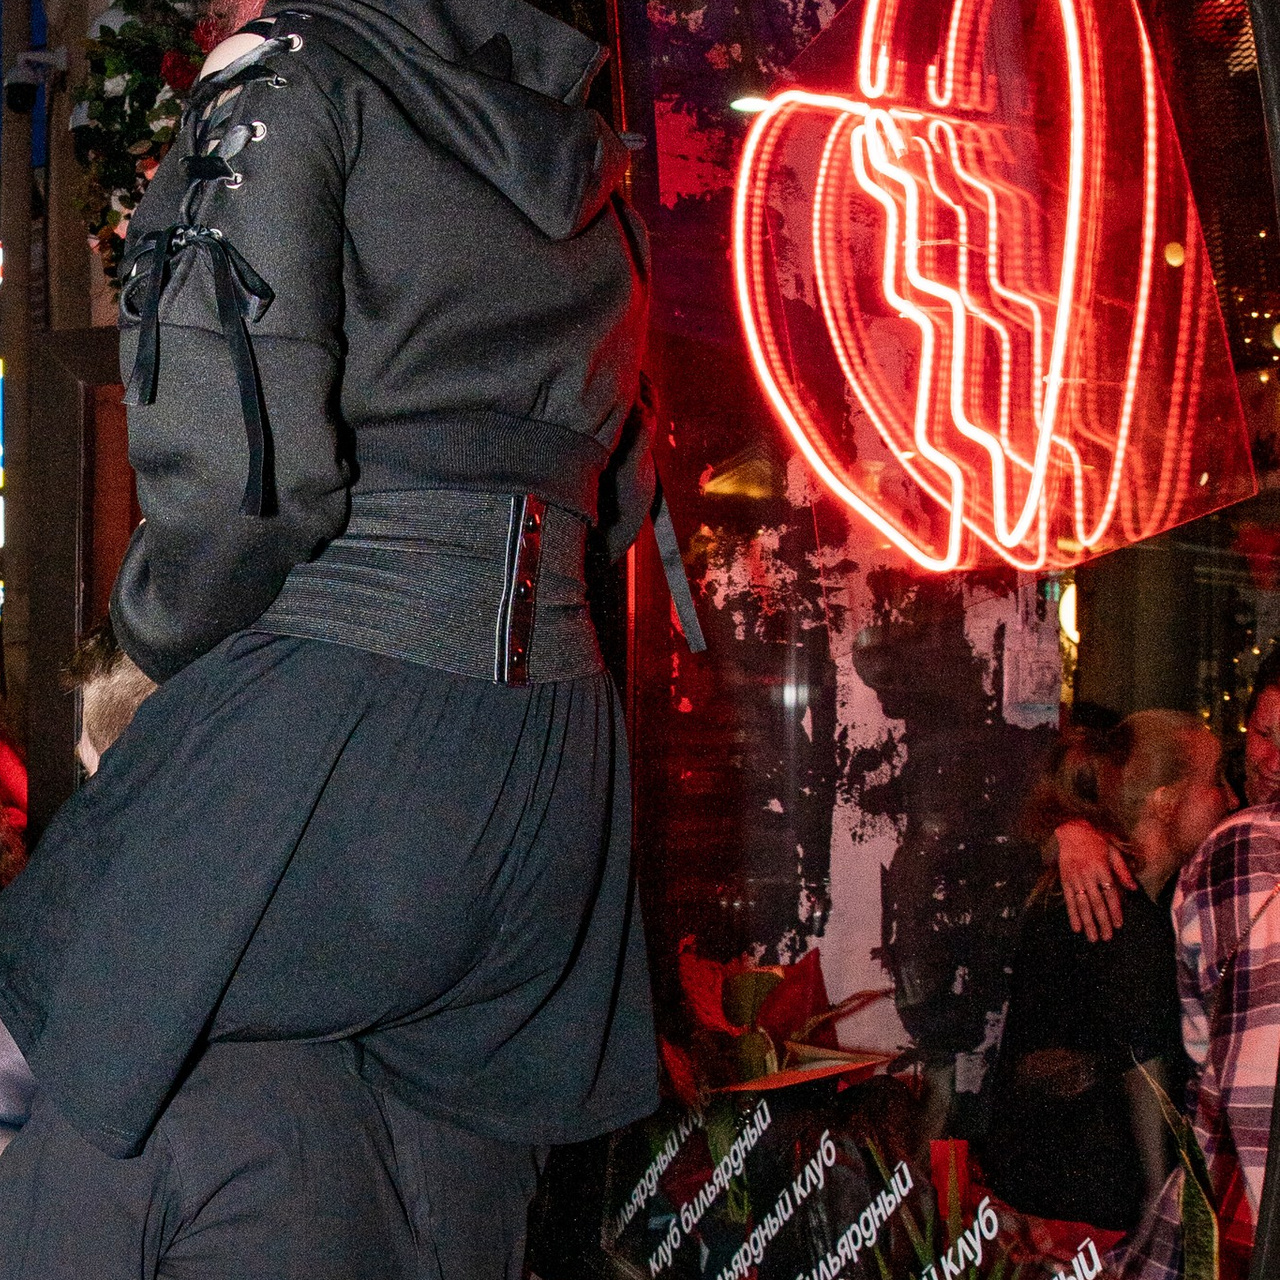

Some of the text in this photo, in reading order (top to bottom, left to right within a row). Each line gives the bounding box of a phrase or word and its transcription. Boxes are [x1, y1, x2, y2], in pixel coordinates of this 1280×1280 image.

[649, 1098, 772, 1279] клуб бильярдный
[791, 1128, 837, 1205] клуб
